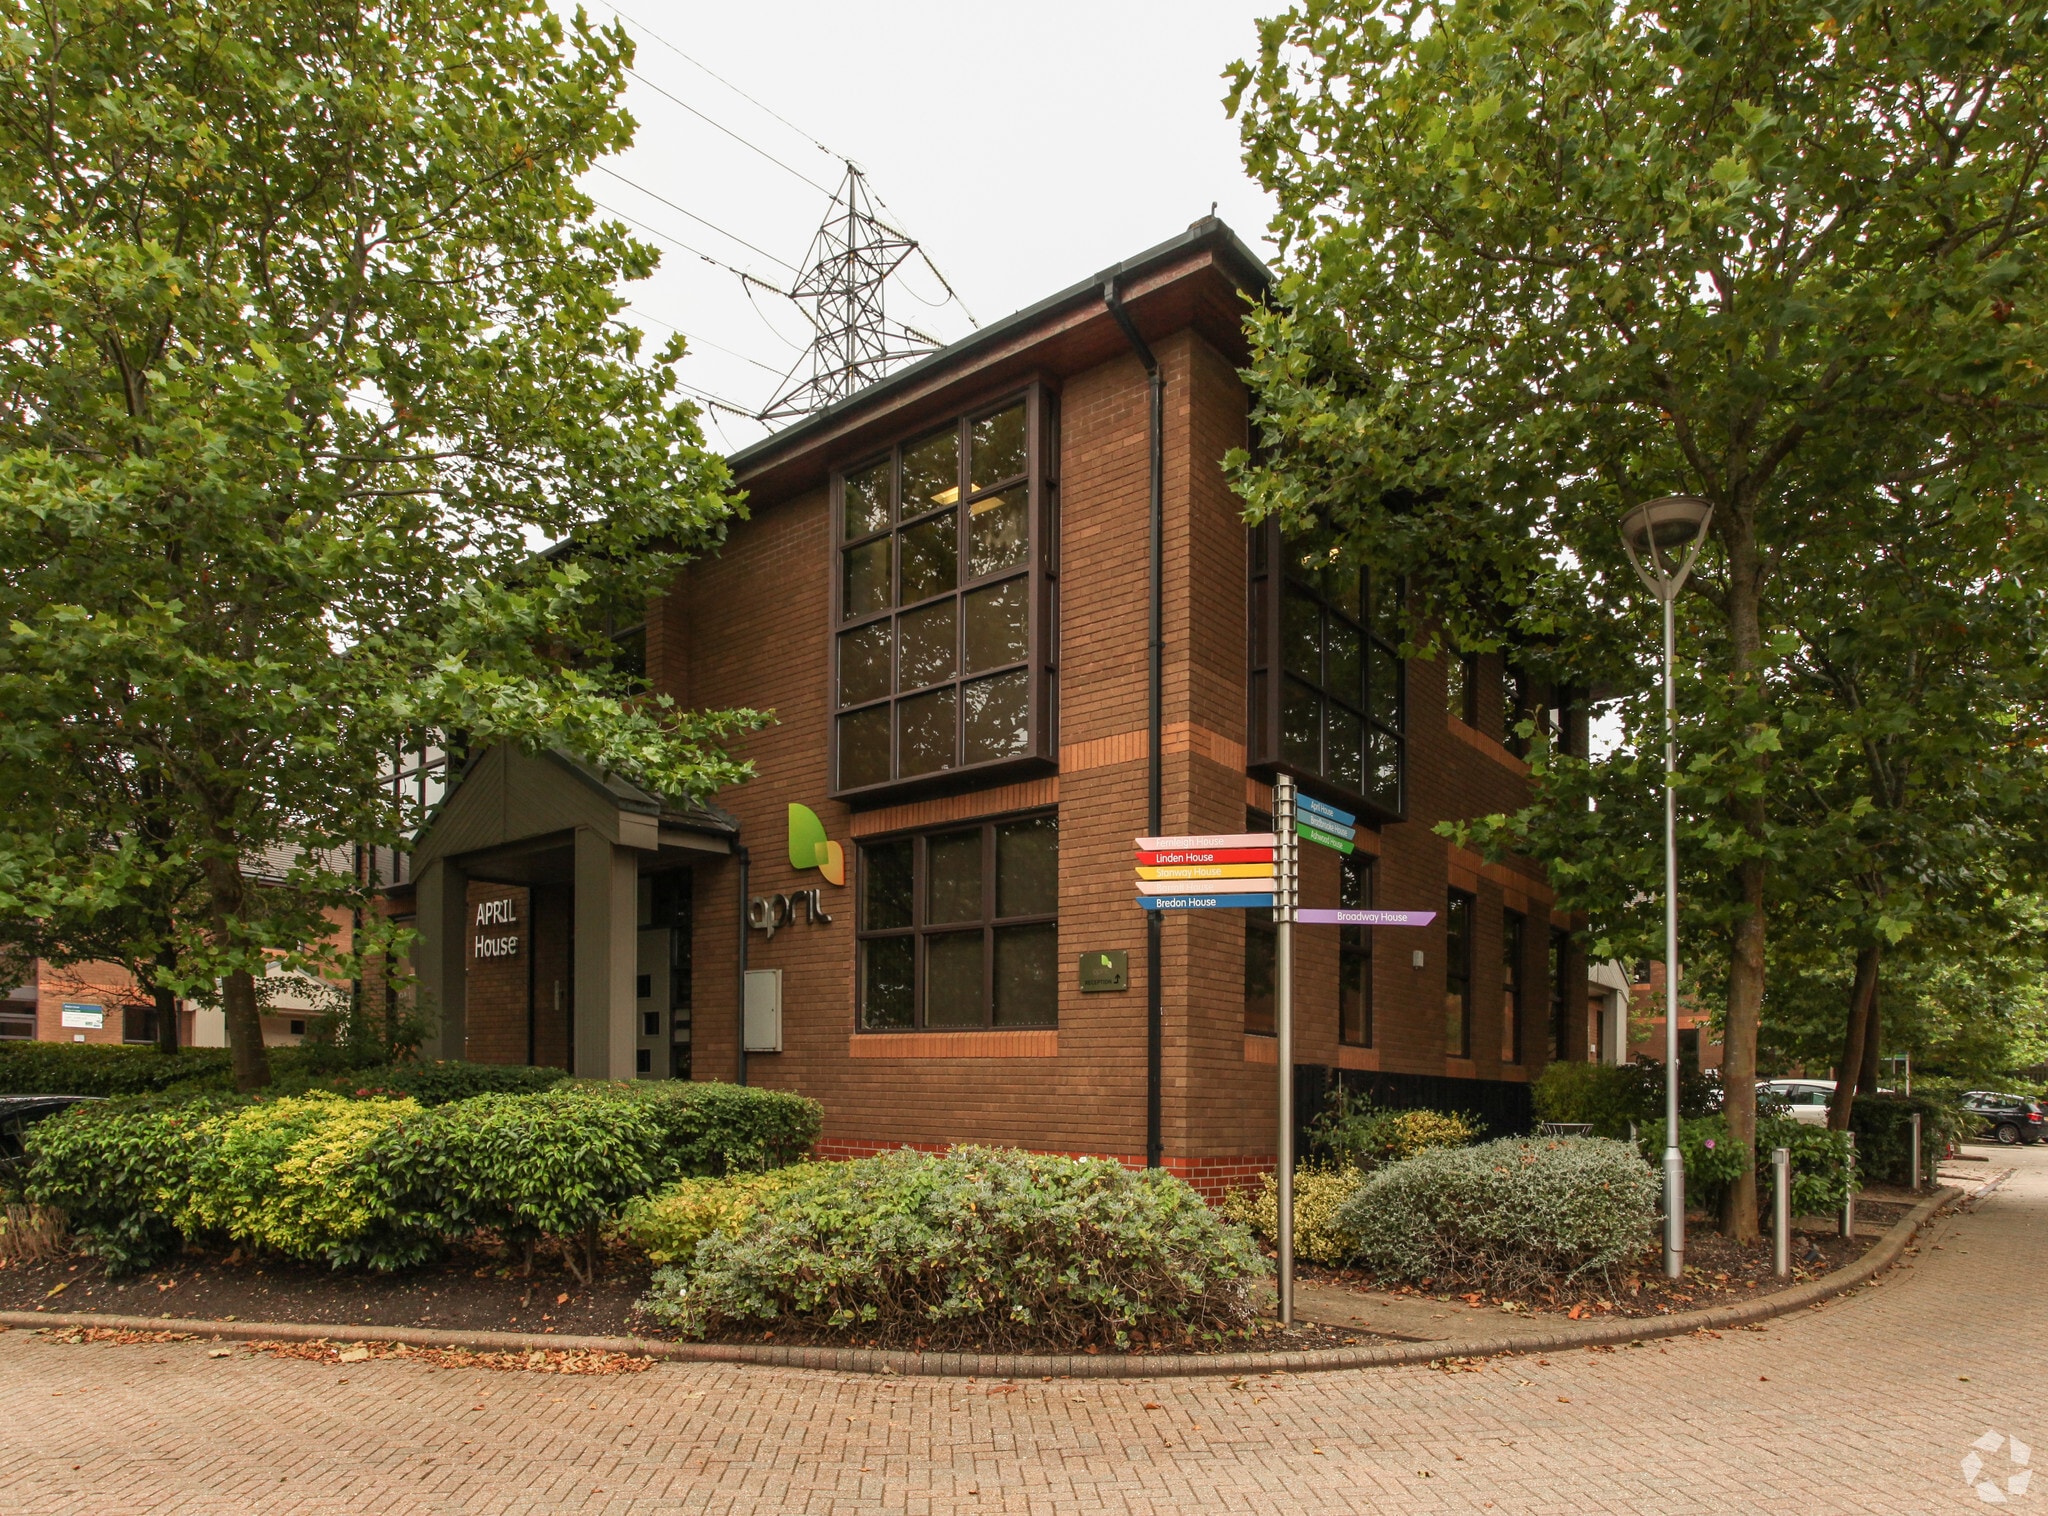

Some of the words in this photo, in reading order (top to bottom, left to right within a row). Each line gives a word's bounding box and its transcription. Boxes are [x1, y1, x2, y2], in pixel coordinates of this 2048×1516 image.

[1321, 804, 1334, 817] House
[1335, 824, 1348, 837] House
[1156, 838, 1194, 849] Fernleigh
[1196, 837, 1224, 845] House
[1310, 830, 1330, 845] Ashwood
[1331, 837, 1344, 850] House
[1156, 853, 1184, 863] Linden
[1186, 852, 1214, 862] House
[1157, 868, 1192, 878] Stanway
[1194, 867, 1221, 876] House
[1156, 898, 1187, 907] Bredon
[1188, 898, 1216, 907] House
[475, 898, 517, 927] APRIL
[747, 888, 832, 941] april
[1337, 911, 1380, 924] Broadway
[1381, 912, 1408, 922] House
[475, 934, 519, 958] House
